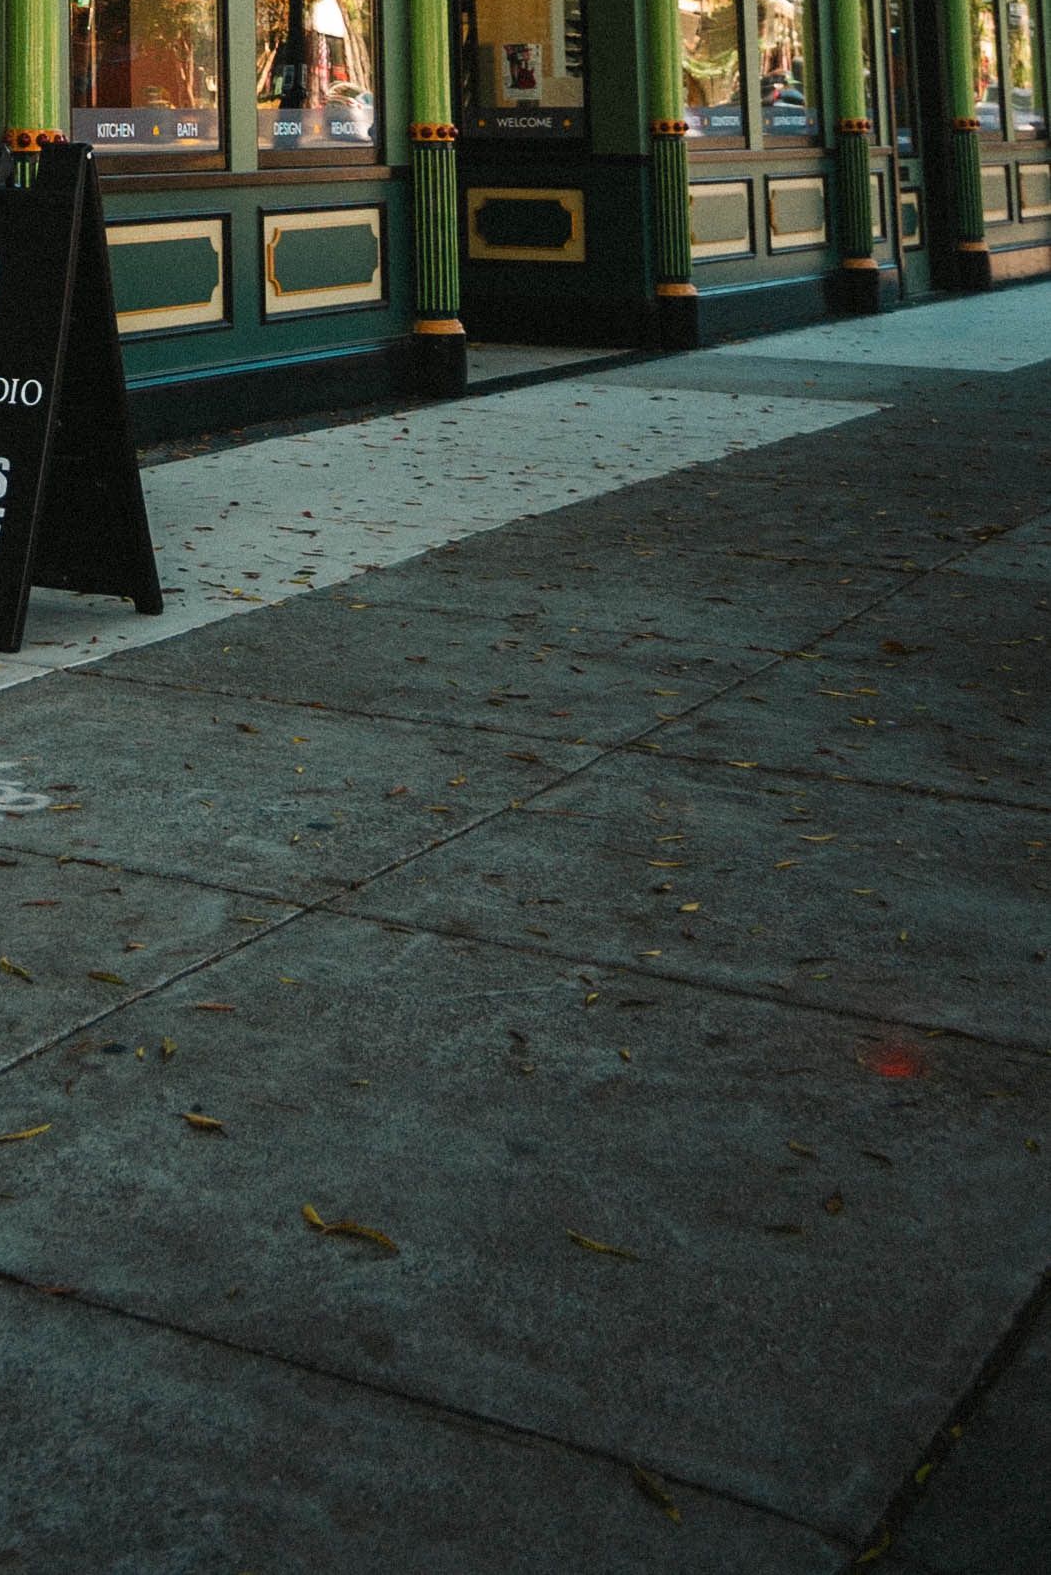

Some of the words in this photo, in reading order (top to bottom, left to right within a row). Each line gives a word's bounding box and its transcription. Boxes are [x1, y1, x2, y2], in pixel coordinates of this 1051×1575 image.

[97, 123, 135, 138] KITCHEN
[177, 123, 199, 137] BATH
[273, 121, 302, 136] DESIGN
[496, 117, 553, 129] WELCOME
